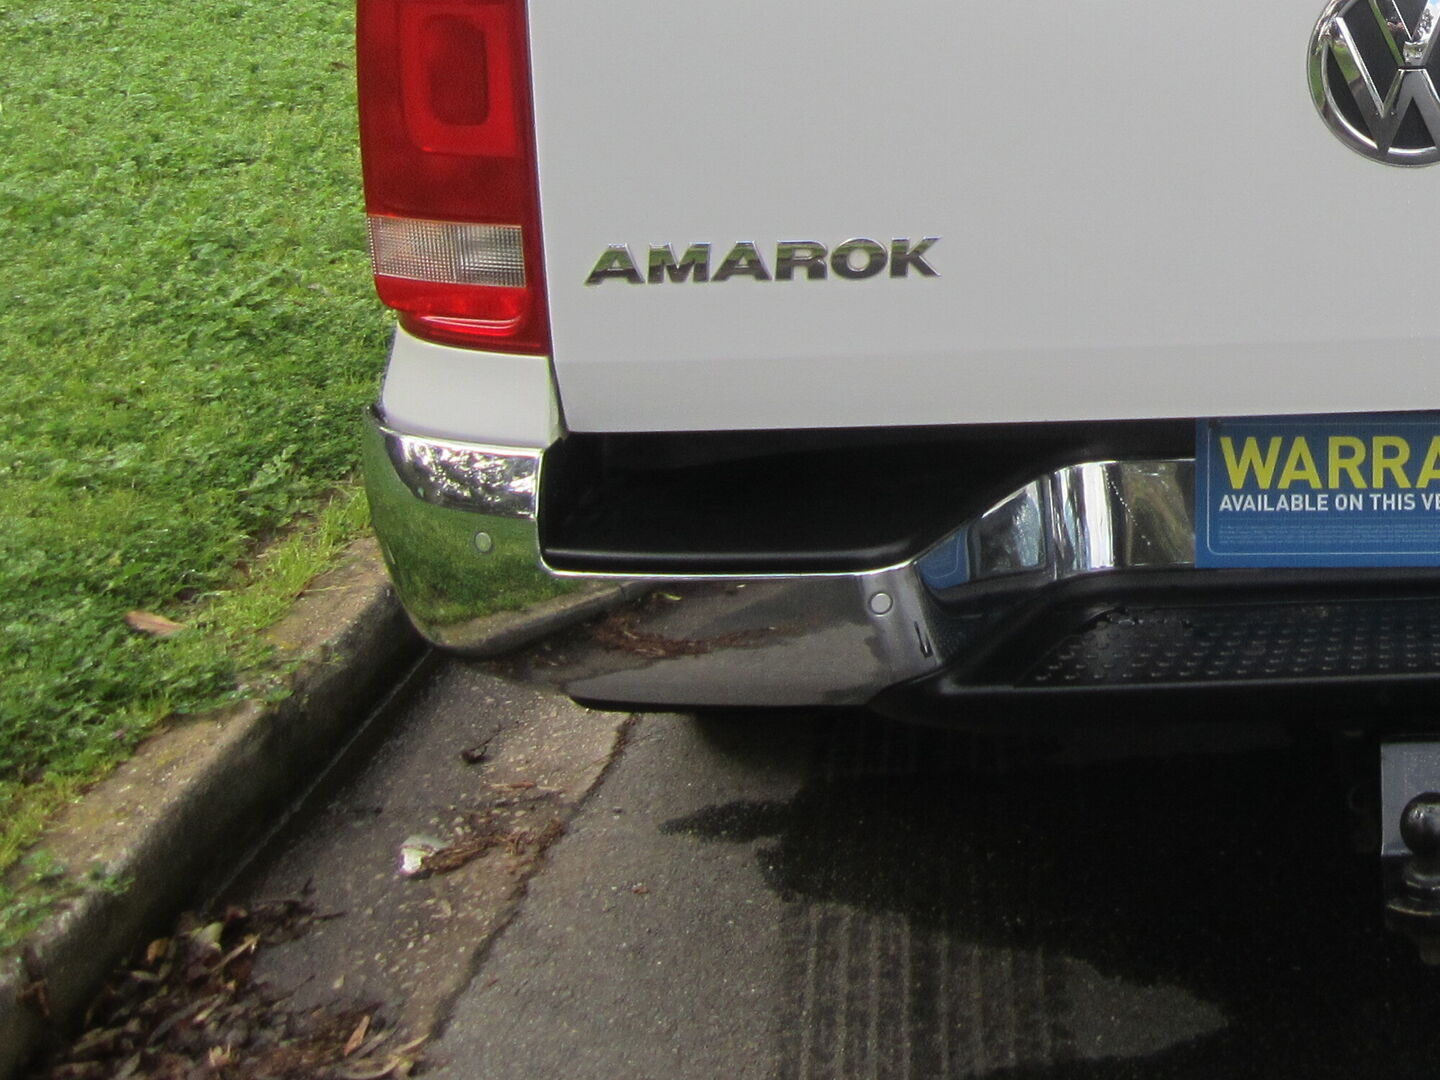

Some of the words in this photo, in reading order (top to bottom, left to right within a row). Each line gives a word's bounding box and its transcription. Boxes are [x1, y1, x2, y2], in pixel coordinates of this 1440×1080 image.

[584, 237, 942, 285] AMAROK
[1219, 494, 1329, 512] AVAILABLE
[1335, 494, 1363, 511] ON
[1370, 493, 1416, 510] THIS
